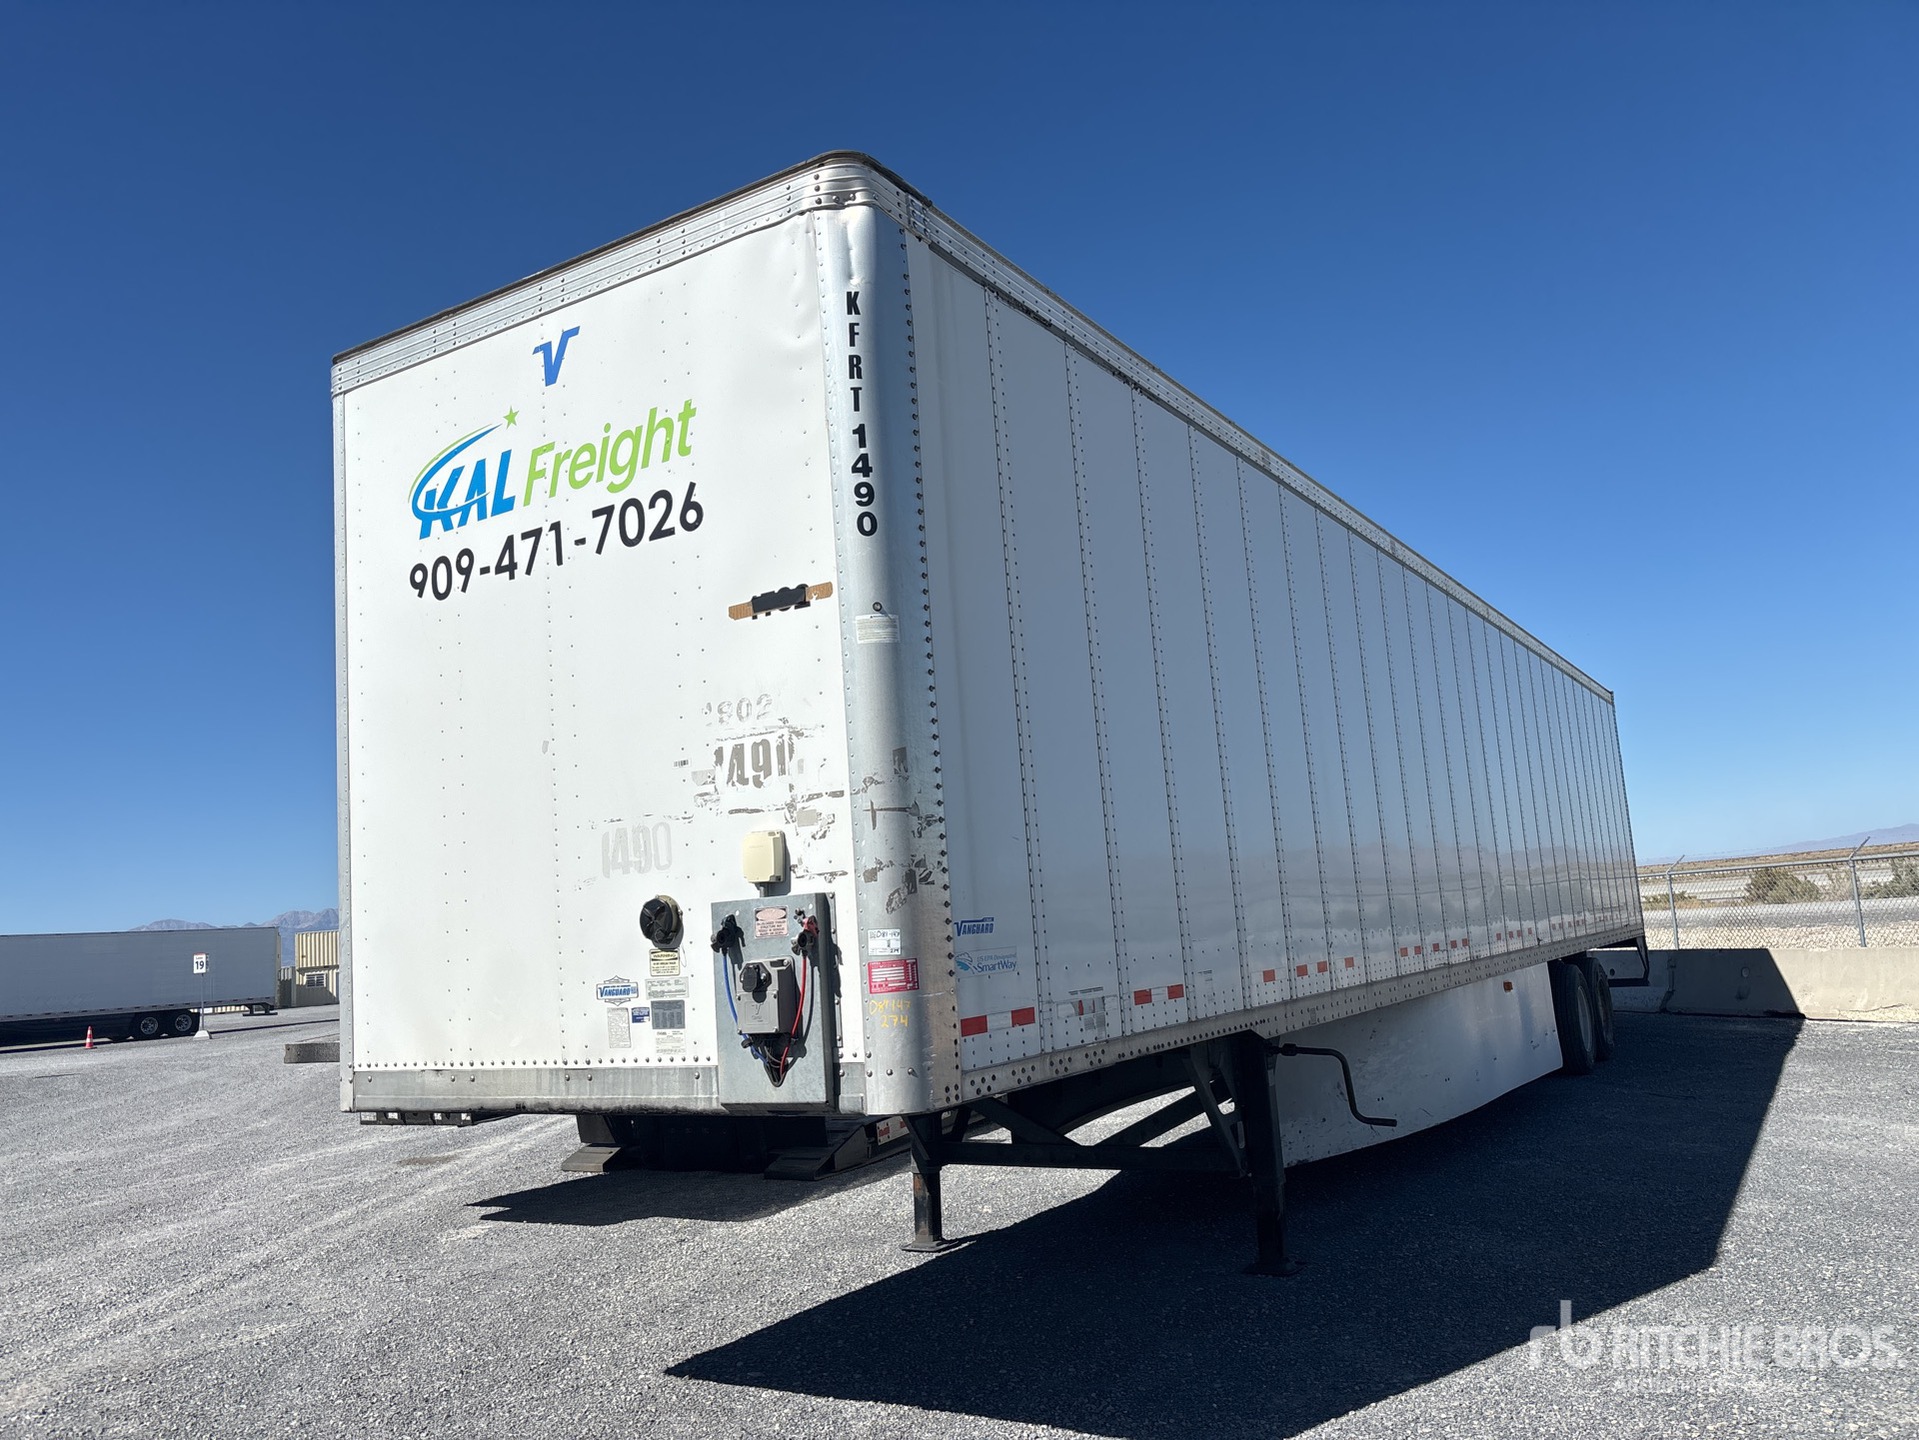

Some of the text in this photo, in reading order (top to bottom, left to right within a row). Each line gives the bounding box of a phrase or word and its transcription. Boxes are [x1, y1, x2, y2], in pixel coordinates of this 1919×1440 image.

[846, 291, 878, 537] KFRT 1490
[418, 399, 697, 540] KAL Freight
[409, 481, 704, 601] 909-471-7026
[954, 917, 994, 936] VANGUARD
[195, 960, 204, 970] 19
[976, 960, 1017, 972] SmartWay
